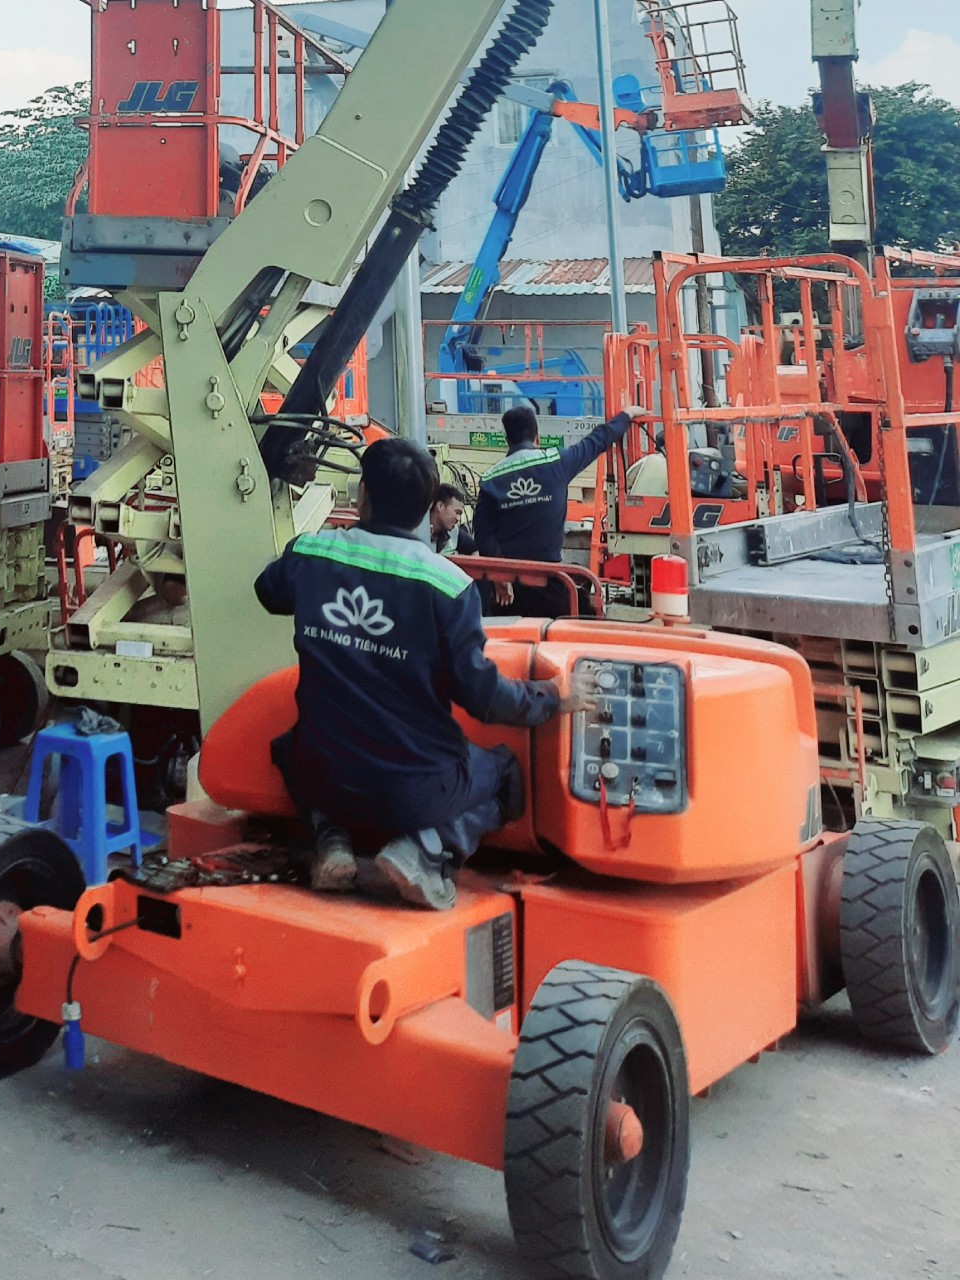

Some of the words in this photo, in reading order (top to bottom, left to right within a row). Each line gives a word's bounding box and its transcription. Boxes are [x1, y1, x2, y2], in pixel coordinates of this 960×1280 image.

[116, 81, 199, 112] JLG
[7, 337, 32, 366] JLG
[649, 503, 724, 529] JG
[304, 625, 318, 638] XE
